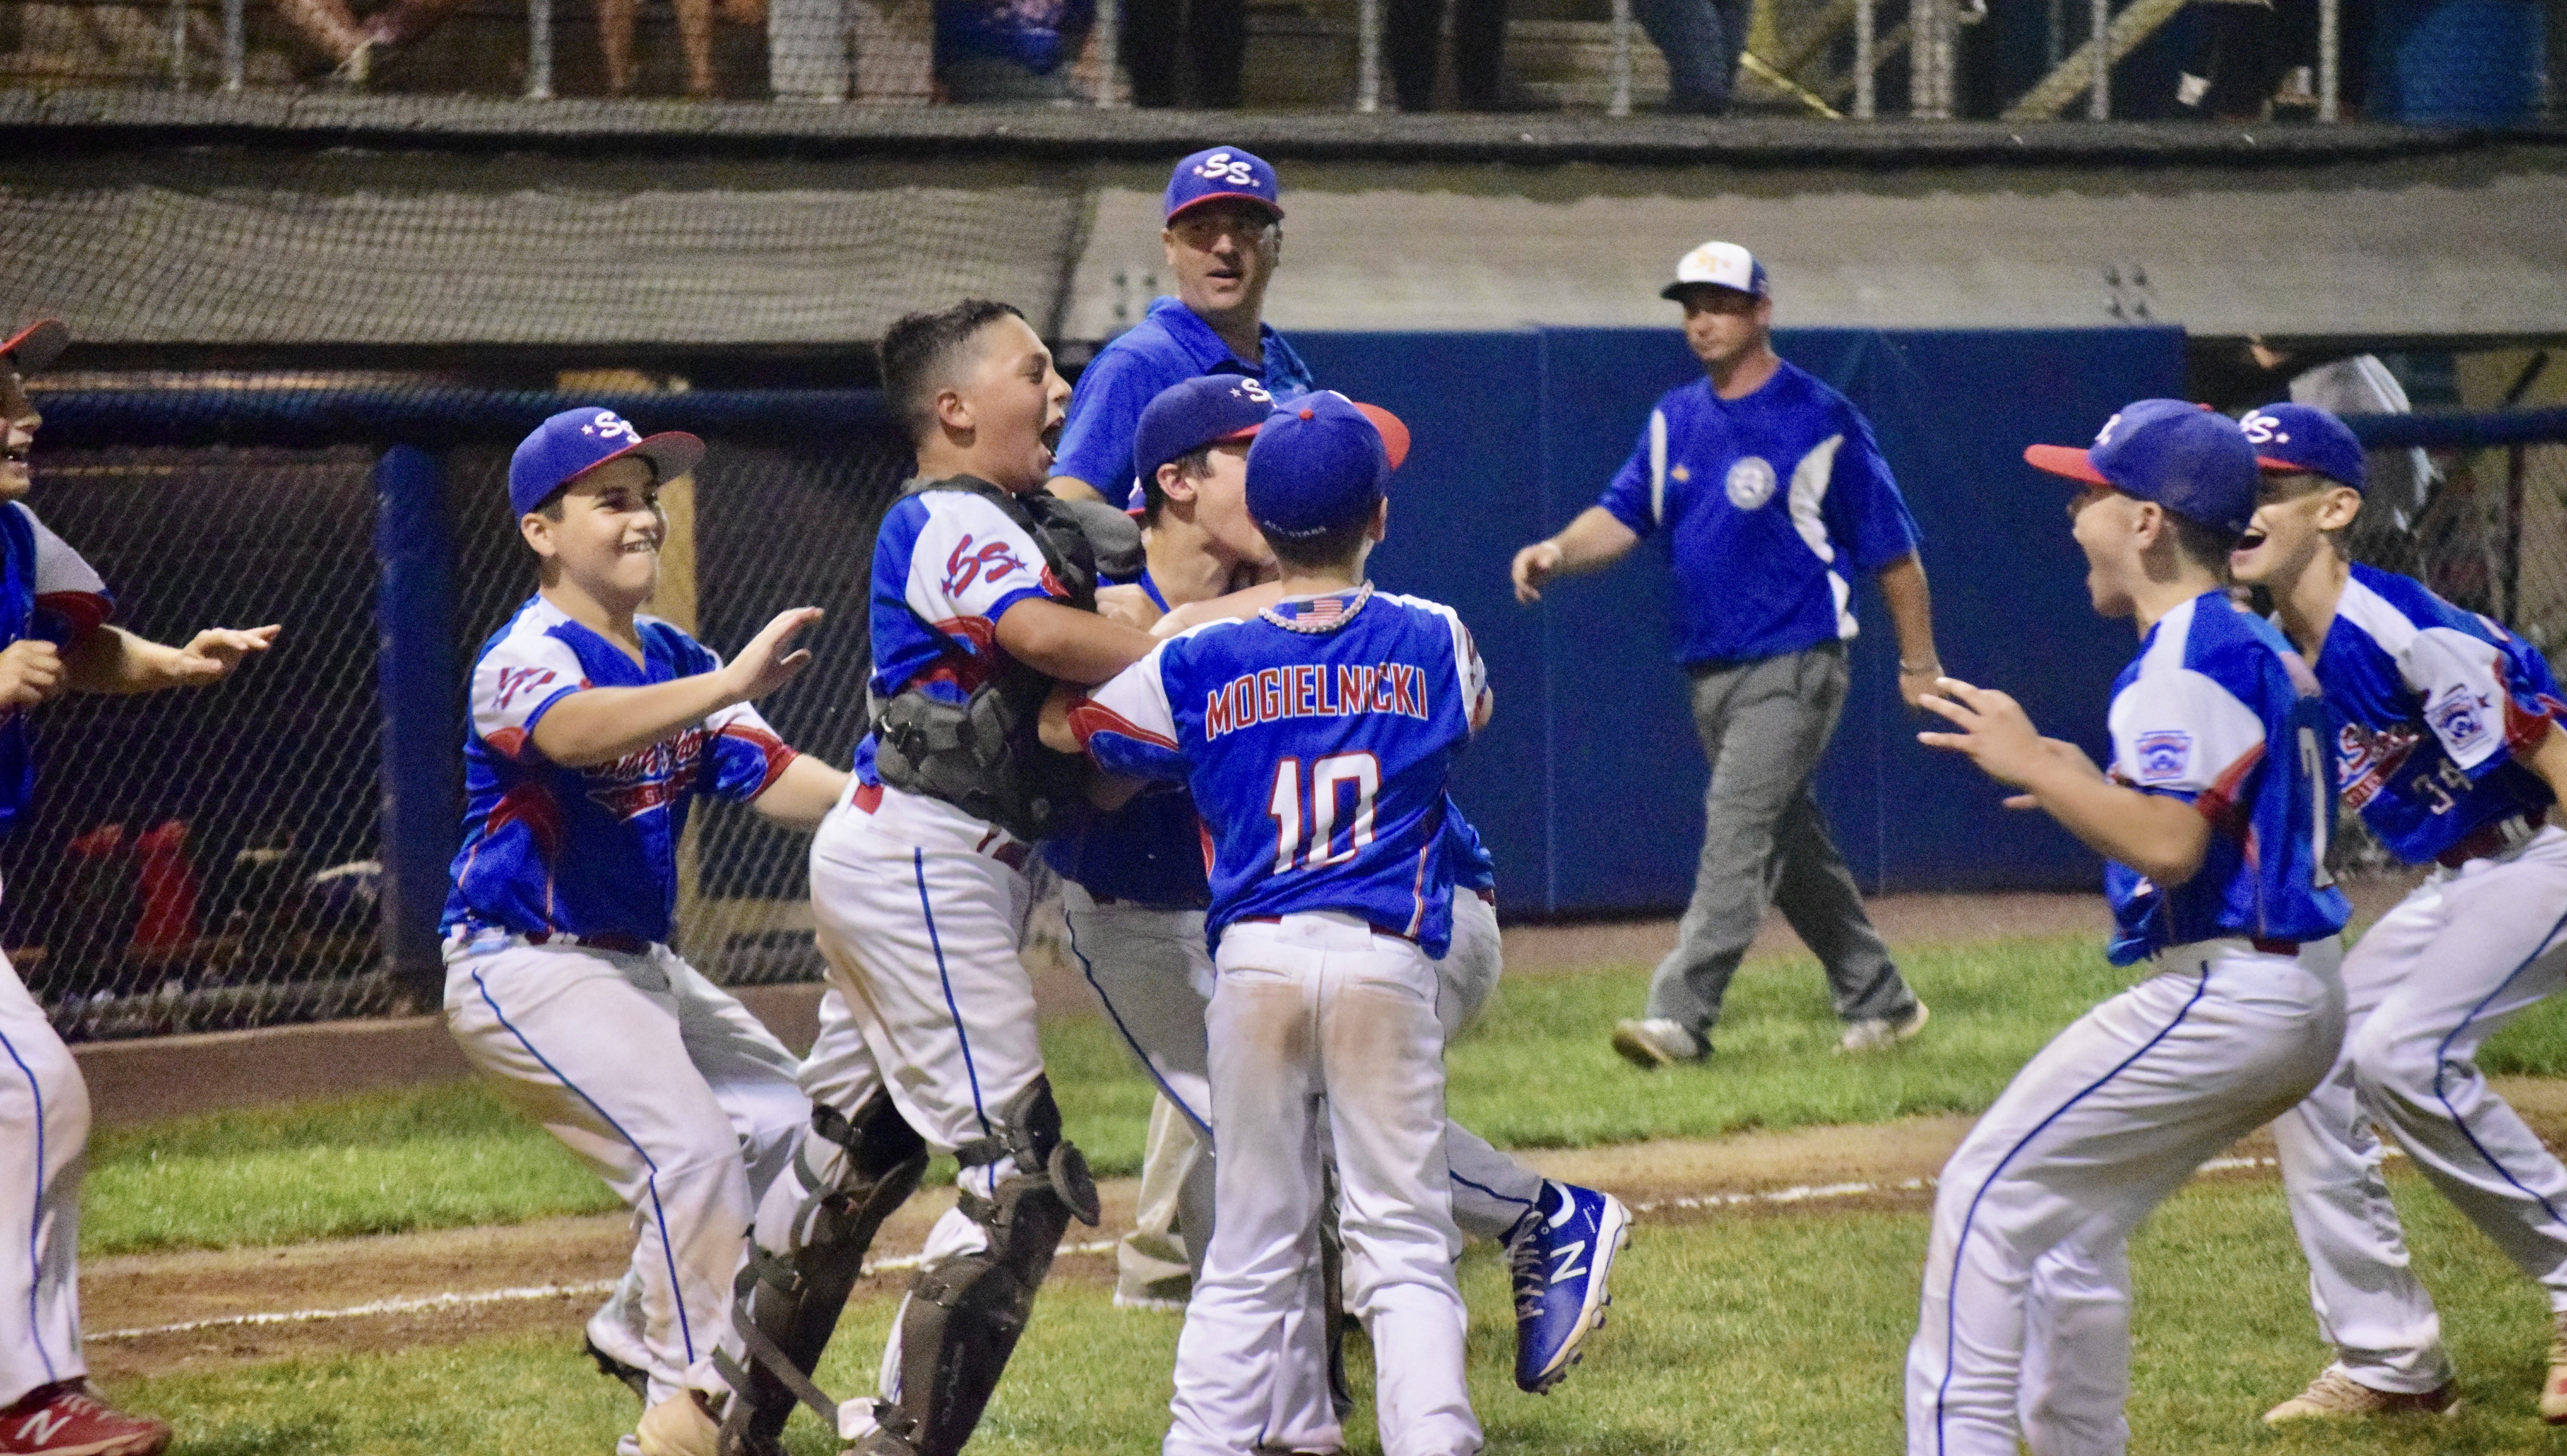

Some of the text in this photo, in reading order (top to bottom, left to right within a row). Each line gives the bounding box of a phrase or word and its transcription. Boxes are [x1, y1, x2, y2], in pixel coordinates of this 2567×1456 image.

[1203, 153, 1251, 185] SS
[946, 533, 1015, 598] SS
[1206, 662, 1429, 742] MOGIELNICKI
[1267, 749, 1382, 876] 10
